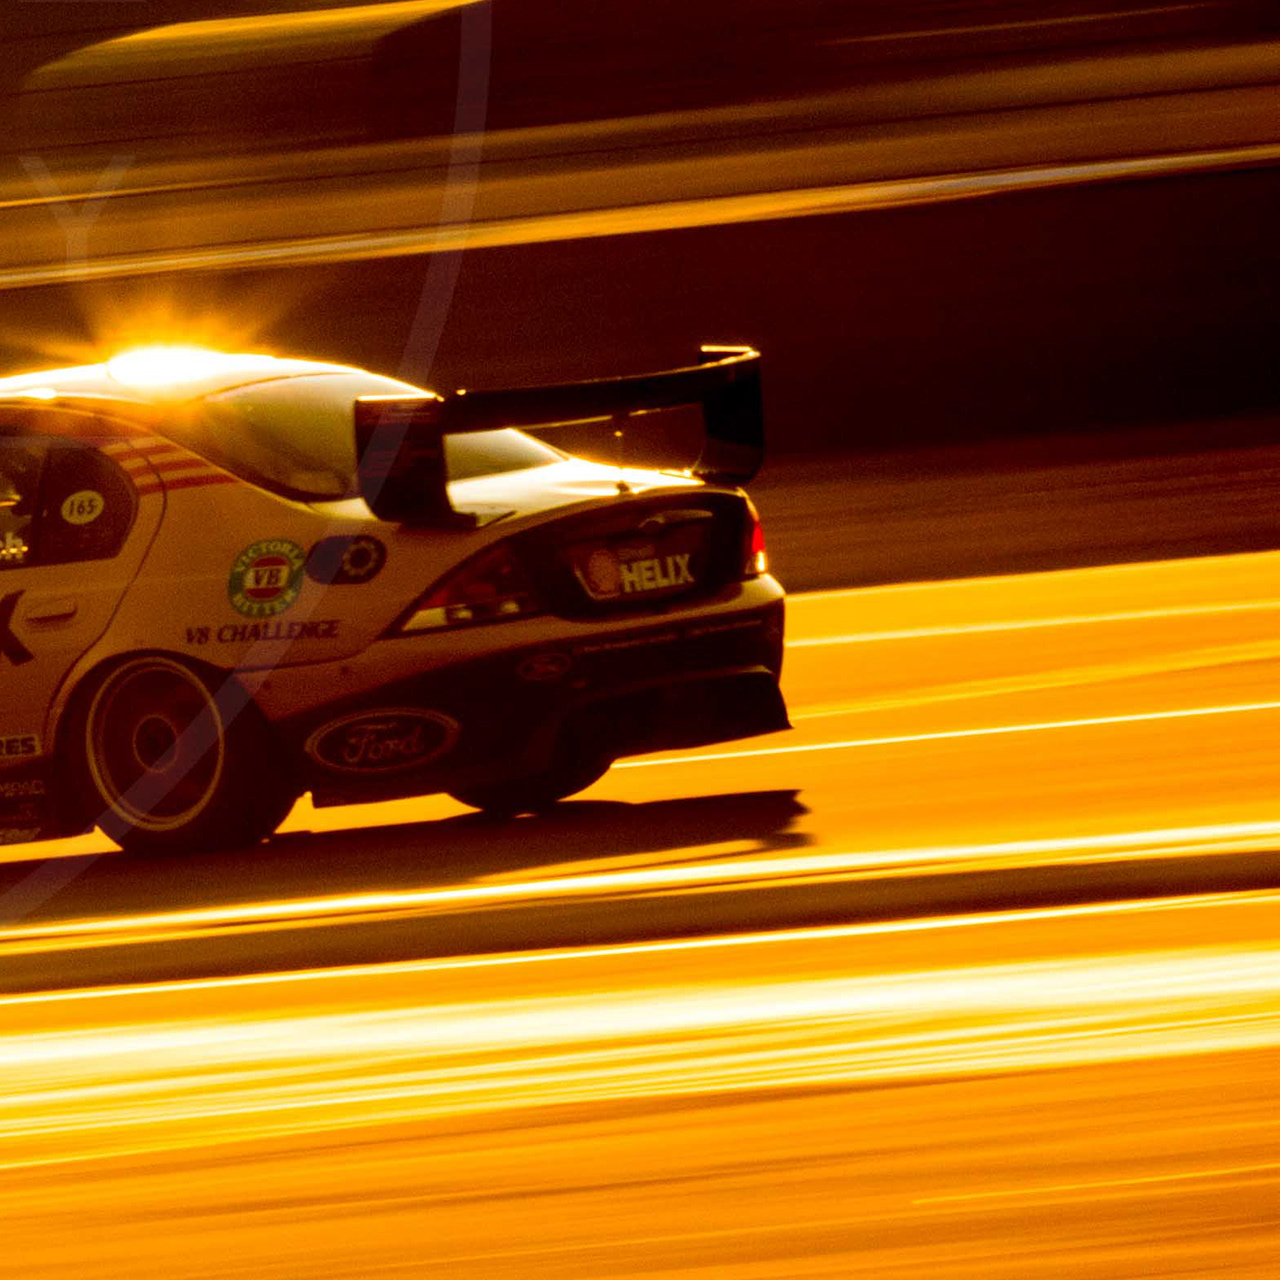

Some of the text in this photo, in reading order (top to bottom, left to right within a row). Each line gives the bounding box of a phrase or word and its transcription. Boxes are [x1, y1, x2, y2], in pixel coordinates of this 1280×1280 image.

[68, 497, 98, 518] 165
[234, 541, 304, 572] VICTORIA
[253, 568, 282, 587] VB
[619, 554, 695, 593] HELIX
[186, 620, 340, 645] V8 CHALLENGE
[344, 721, 423, 763] Ford
